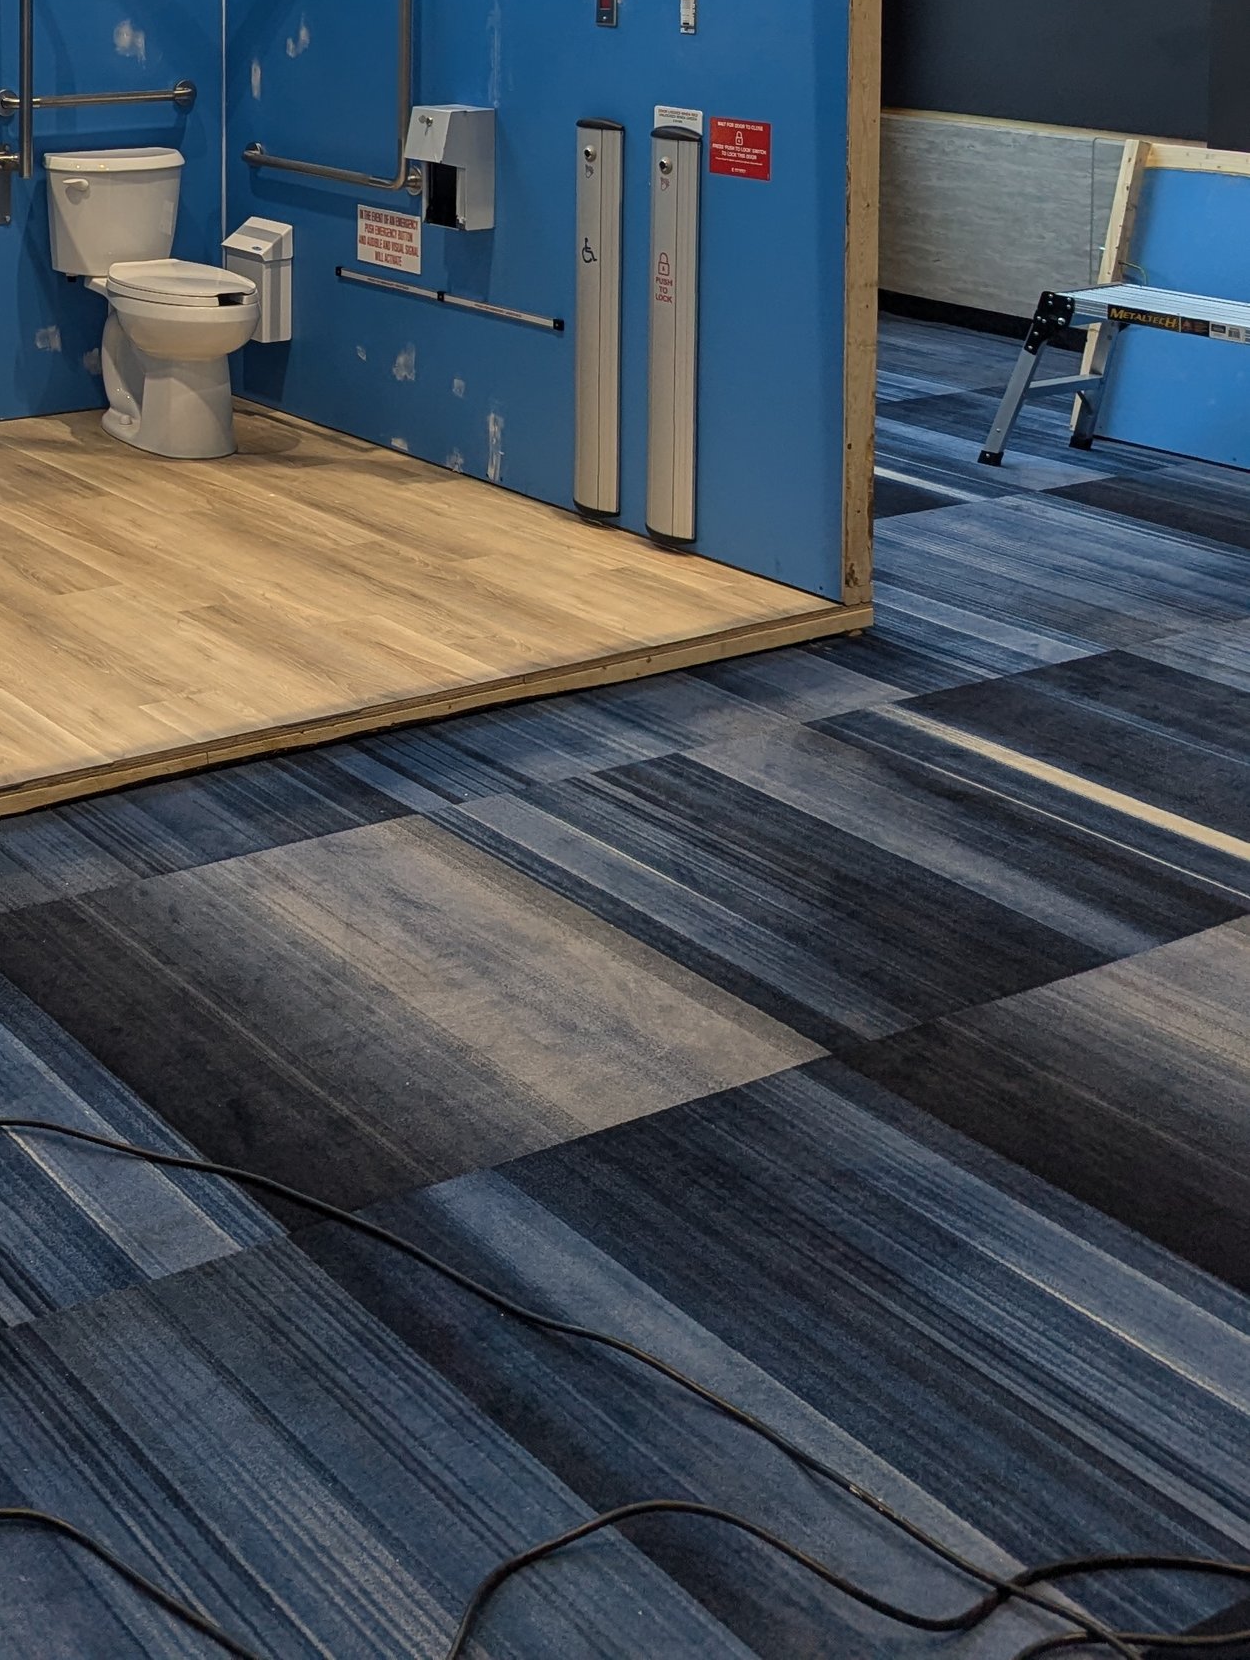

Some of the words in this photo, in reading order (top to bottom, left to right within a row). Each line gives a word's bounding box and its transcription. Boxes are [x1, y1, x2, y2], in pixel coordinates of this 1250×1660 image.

[363, 210, 371, 220] THE
[372, 211, 384, 223] EVENT
[396, 216, 418, 230] EMERGENCY
[365, 223, 374, 234] PUSH
[375, 225, 397, 238] EMERGENCY
[391, 241, 405, 254] VISUAL
[405, 244, 419, 257] SIGNAL
[375, 251, 384, 262] WILL
[384, 253, 402, 267] ACTIVATE
[655, 276, 673, 286] PUSH
[658, 286, 668, 294] TO
[655, 293, 673, 304] LOCK
[1110, 307, 1177, 329] METALTECH
